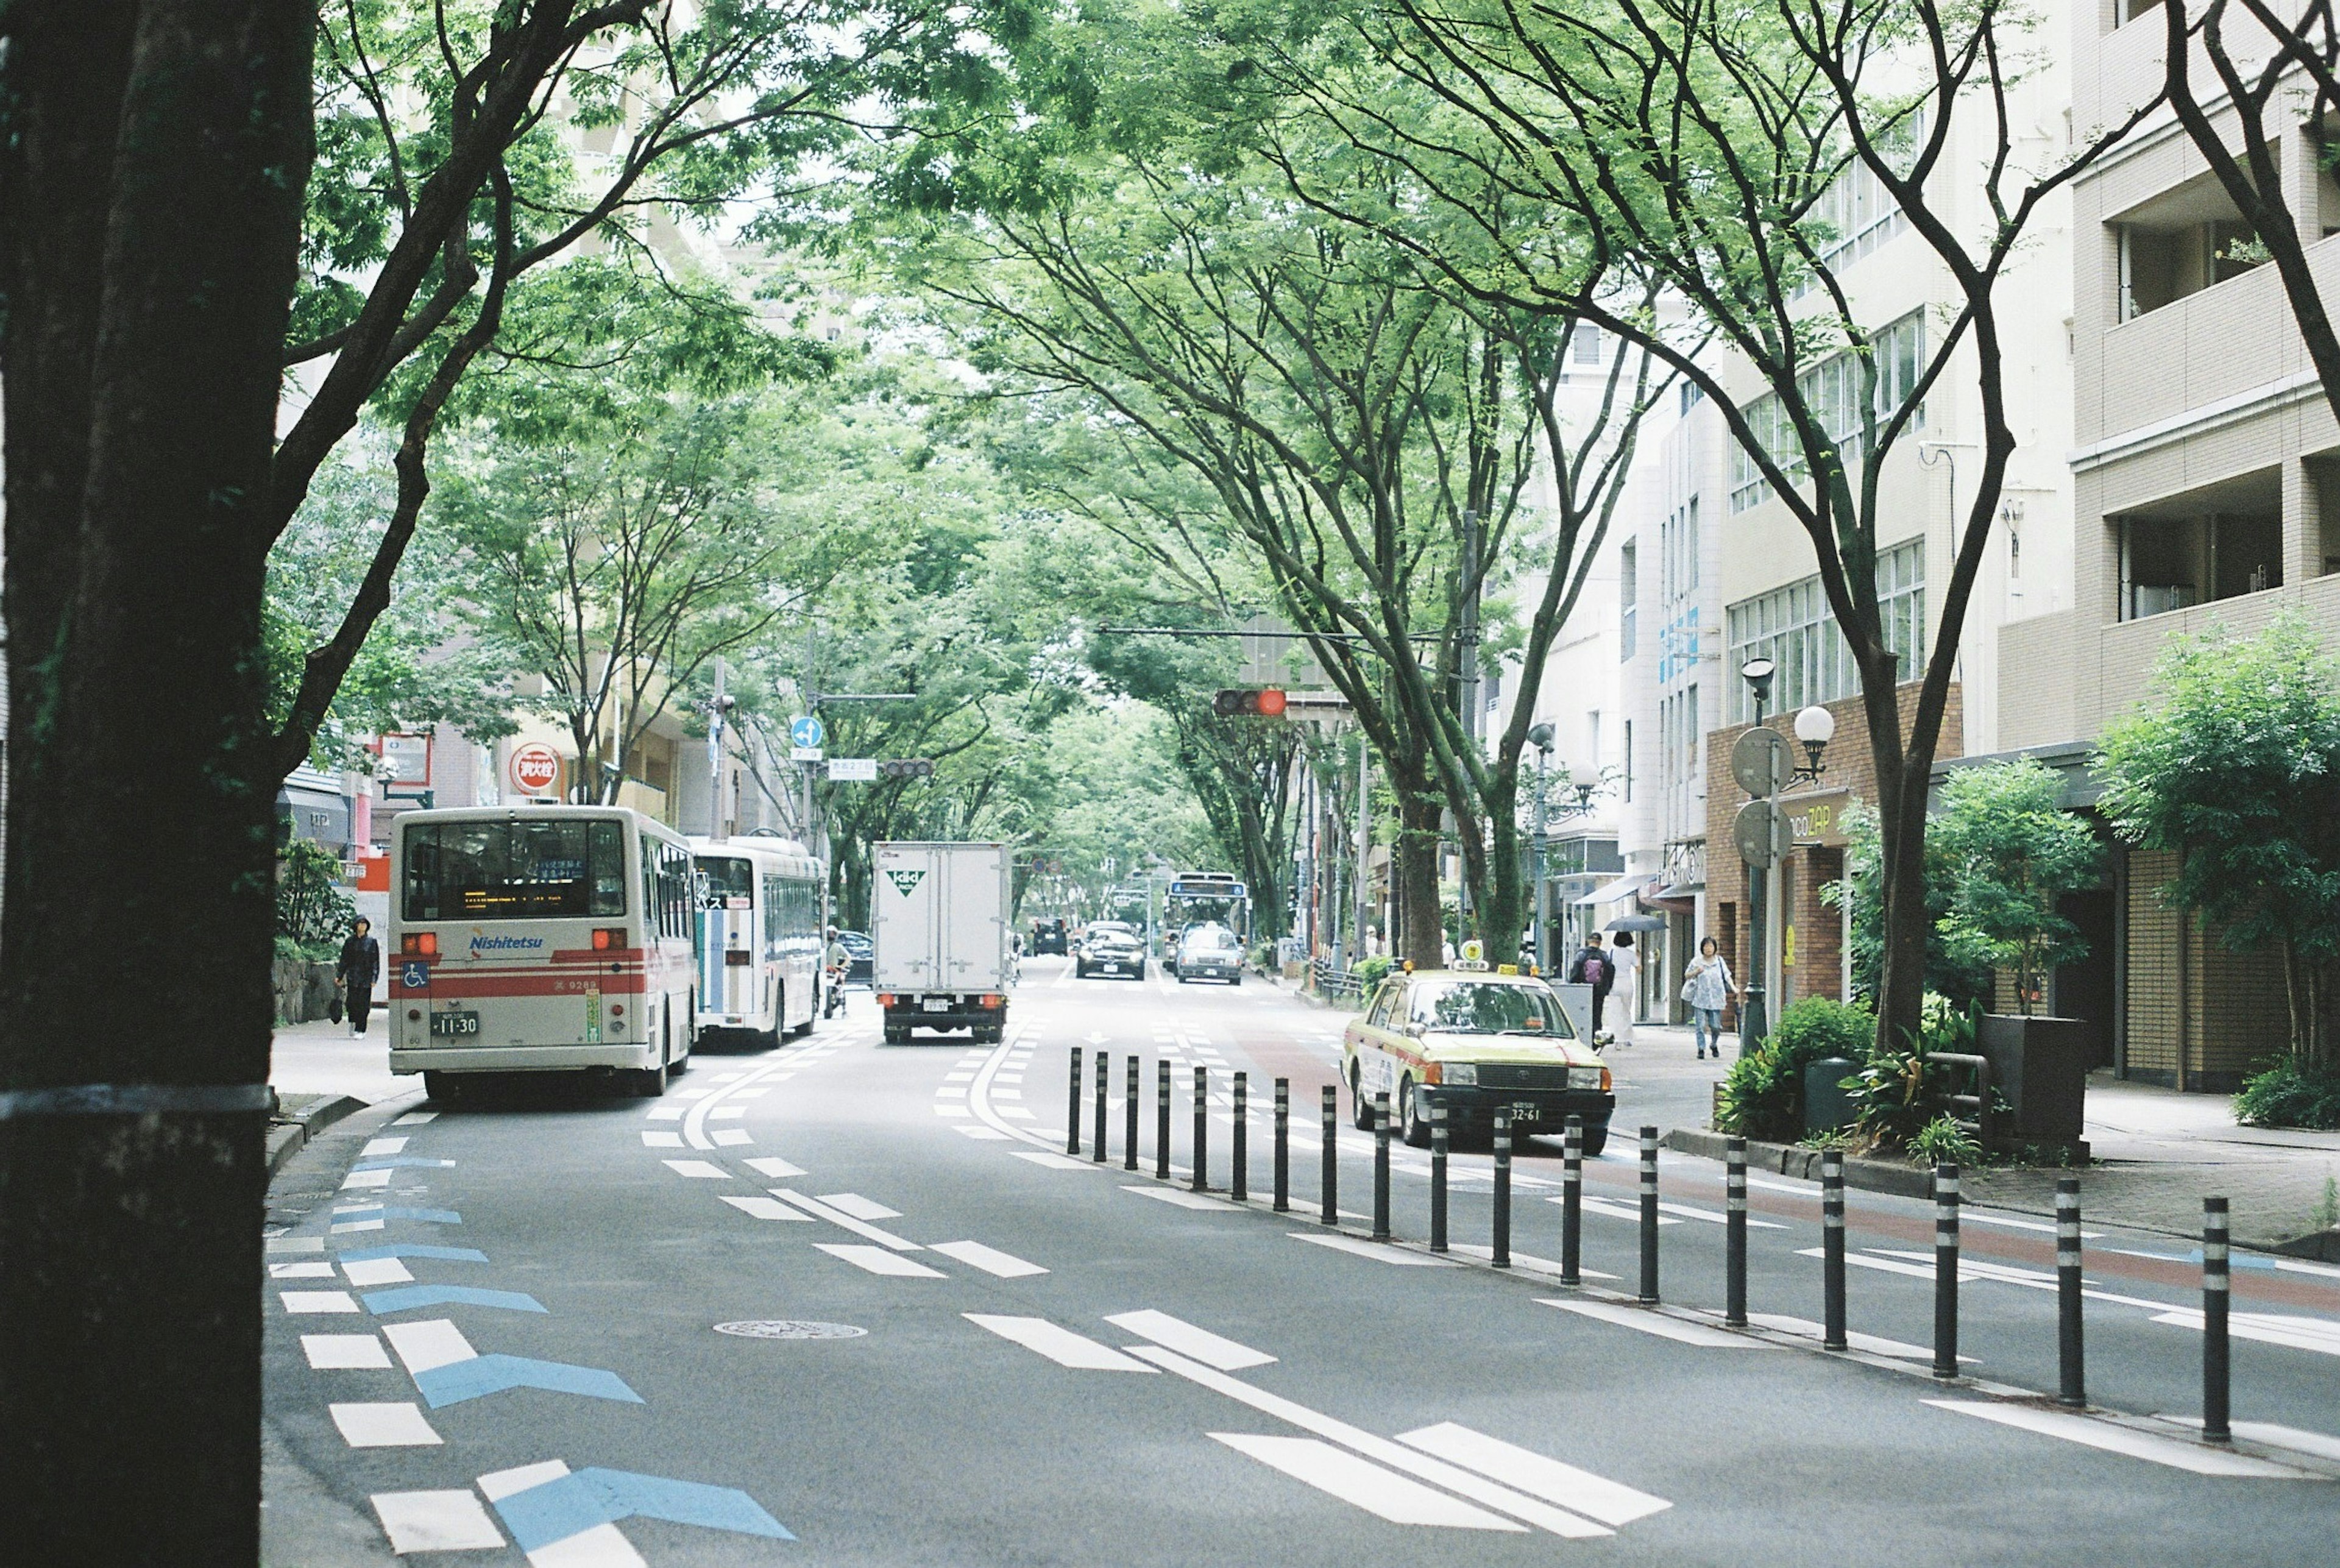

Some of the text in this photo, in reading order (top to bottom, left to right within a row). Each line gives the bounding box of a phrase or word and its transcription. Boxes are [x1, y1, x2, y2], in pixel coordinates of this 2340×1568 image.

[520, 761, 554, 777] 消火栓
[469, 935, 543, 949] Nishitetsu
[1511, 1109, 1539, 1121] 32-61
